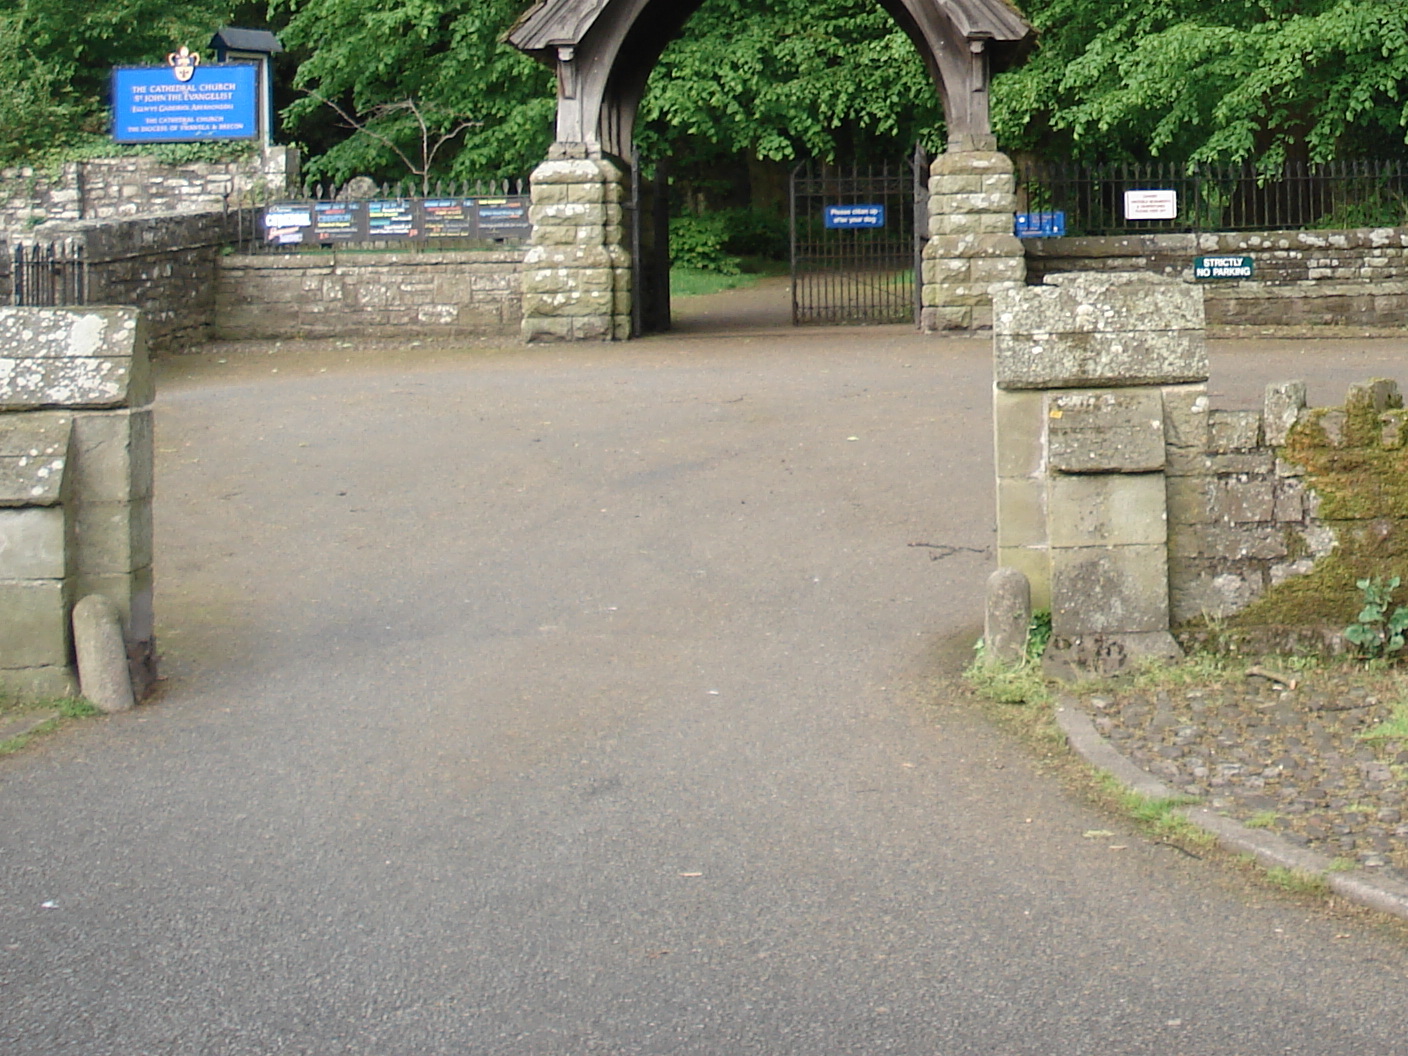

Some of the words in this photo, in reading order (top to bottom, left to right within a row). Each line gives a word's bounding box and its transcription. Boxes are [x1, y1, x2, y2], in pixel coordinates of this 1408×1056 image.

[132, 85, 147, 93] THE
[150, 84, 196, 93] CATHEDRAL
[199, 83, 236, 91] CHURCH
[144, 93, 166, 102] JOHN
[168, 93, 182, 101] THE
[184, 92, 232, 101] EVANGELIST
[159, 116, 194, 124] CATHEDRAL
[830, 208, 851, 216] Please
[849, 216, 863, 224] your
[863, 216, 877, 224] dog
[1203, 257, 1244, 267] STRICTLY
[1196, 267, 1211, 277] NO
[1212, 266, 1251, 277] PARKING
